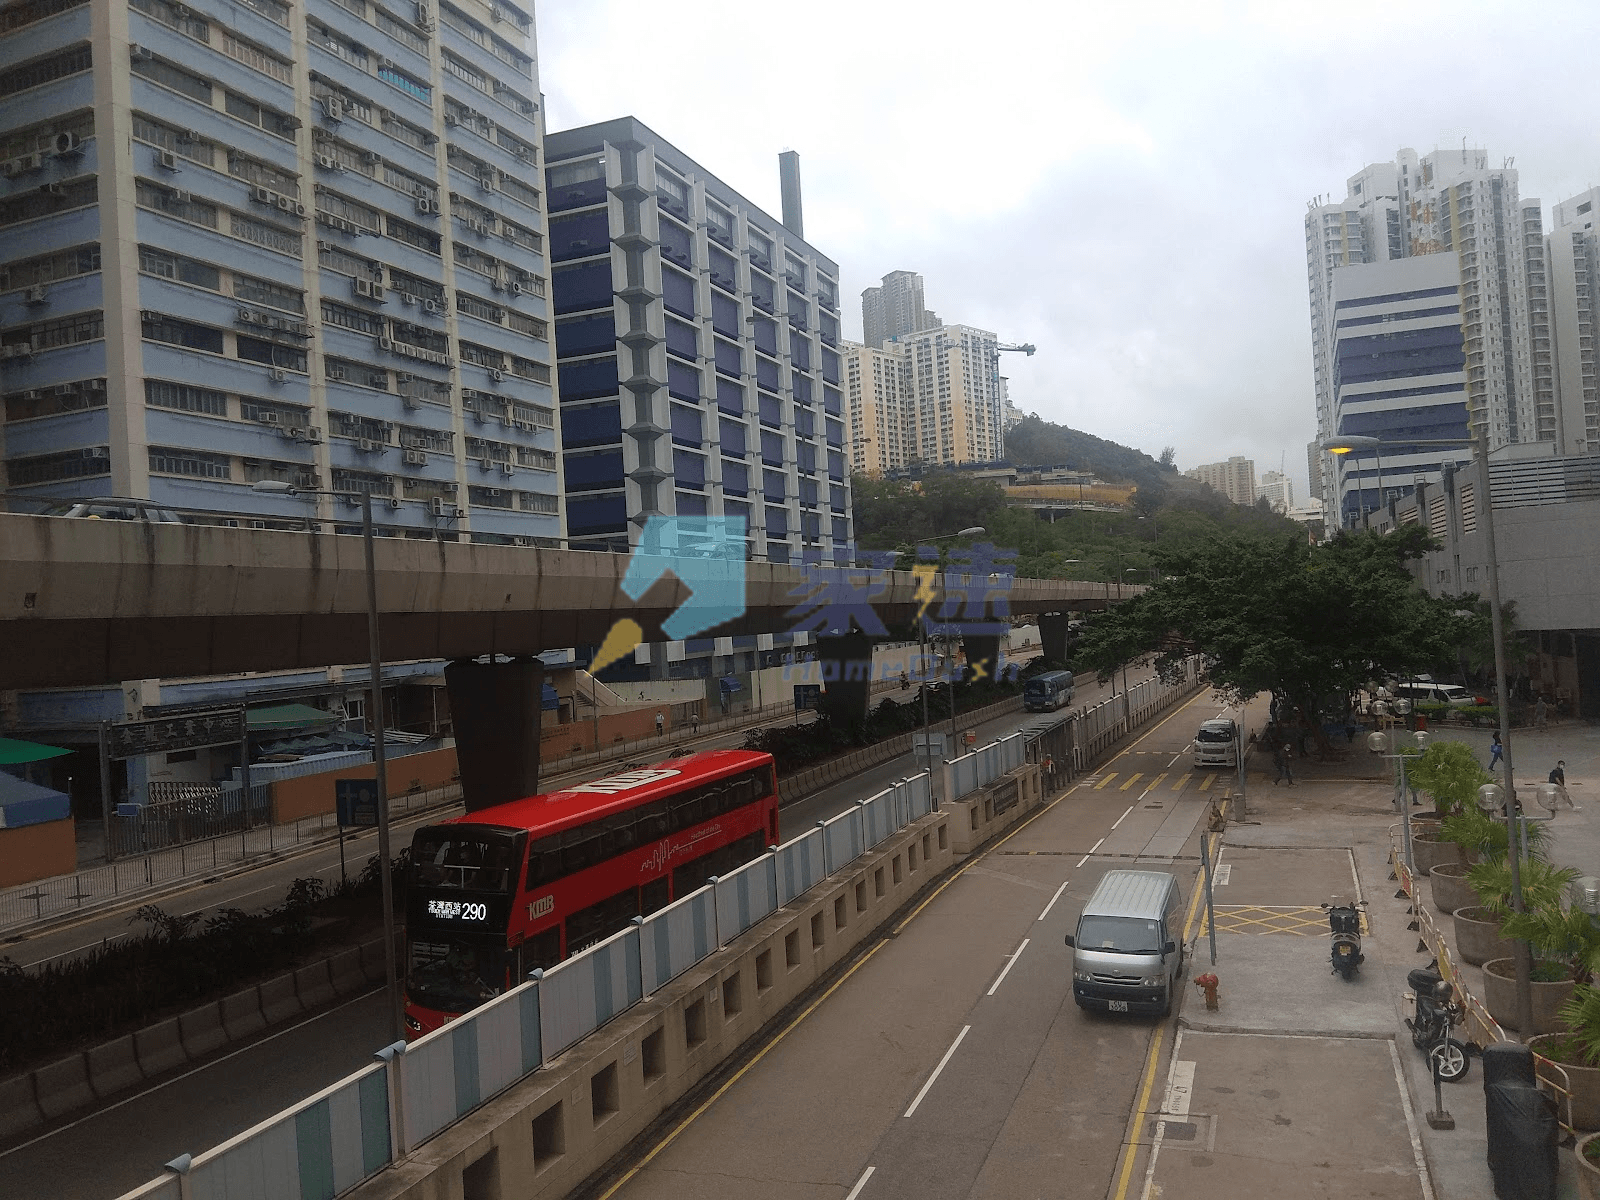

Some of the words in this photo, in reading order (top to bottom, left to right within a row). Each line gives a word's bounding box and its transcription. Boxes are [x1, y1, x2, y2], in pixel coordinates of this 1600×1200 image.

[558, 769, 681, 794] KMB
[462, 903, 486, 921] 290
[528, 895, 554, 921] KMB
